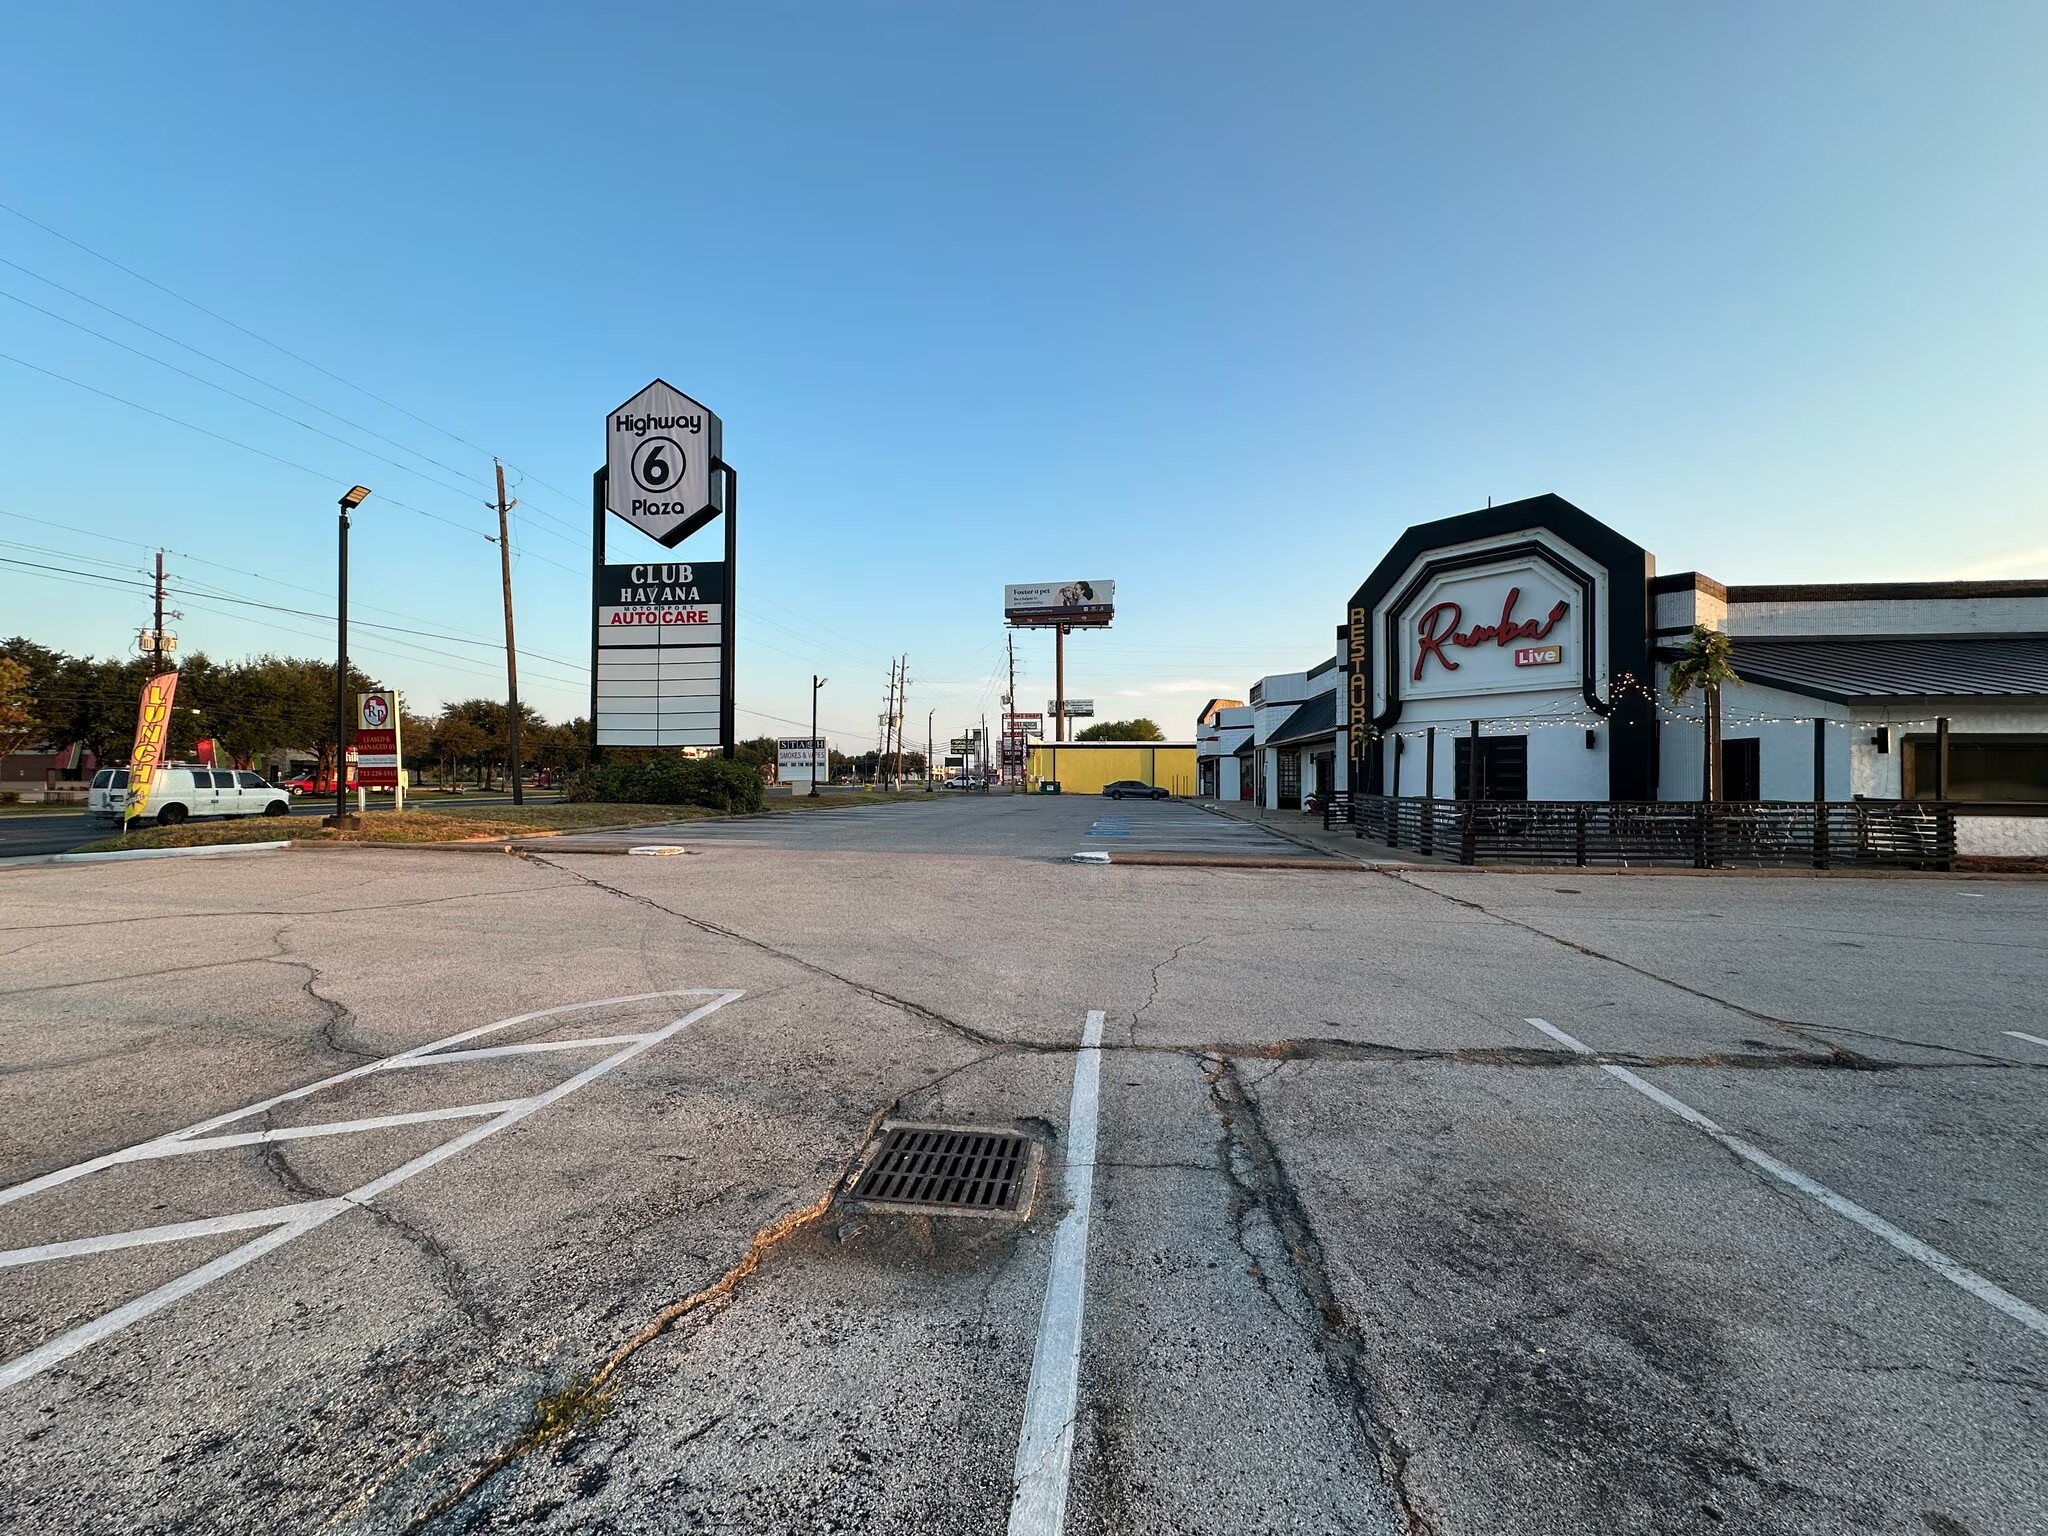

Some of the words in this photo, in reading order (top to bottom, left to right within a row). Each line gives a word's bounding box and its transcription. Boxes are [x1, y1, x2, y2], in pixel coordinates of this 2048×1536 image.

[616, 413, 702, 437] Highway
[642, 445, 670, 486] 6
[631, 499, 685, 516] Plaza
[630, 564, 694, 584] CLUB
[620, 585, 700, 604] HAVANA
[1039, 588, 1050, 596] pet
[610, 612, 658, 624] AUTO
[661, 611, 709, 623] CARE
[1413, 586, 1570, 681] Rumba
[1518, 649, 1557, 664] Live
[132, 685, 167, 784] LUNCH
[779, 751, 802, 759] SMOKES
